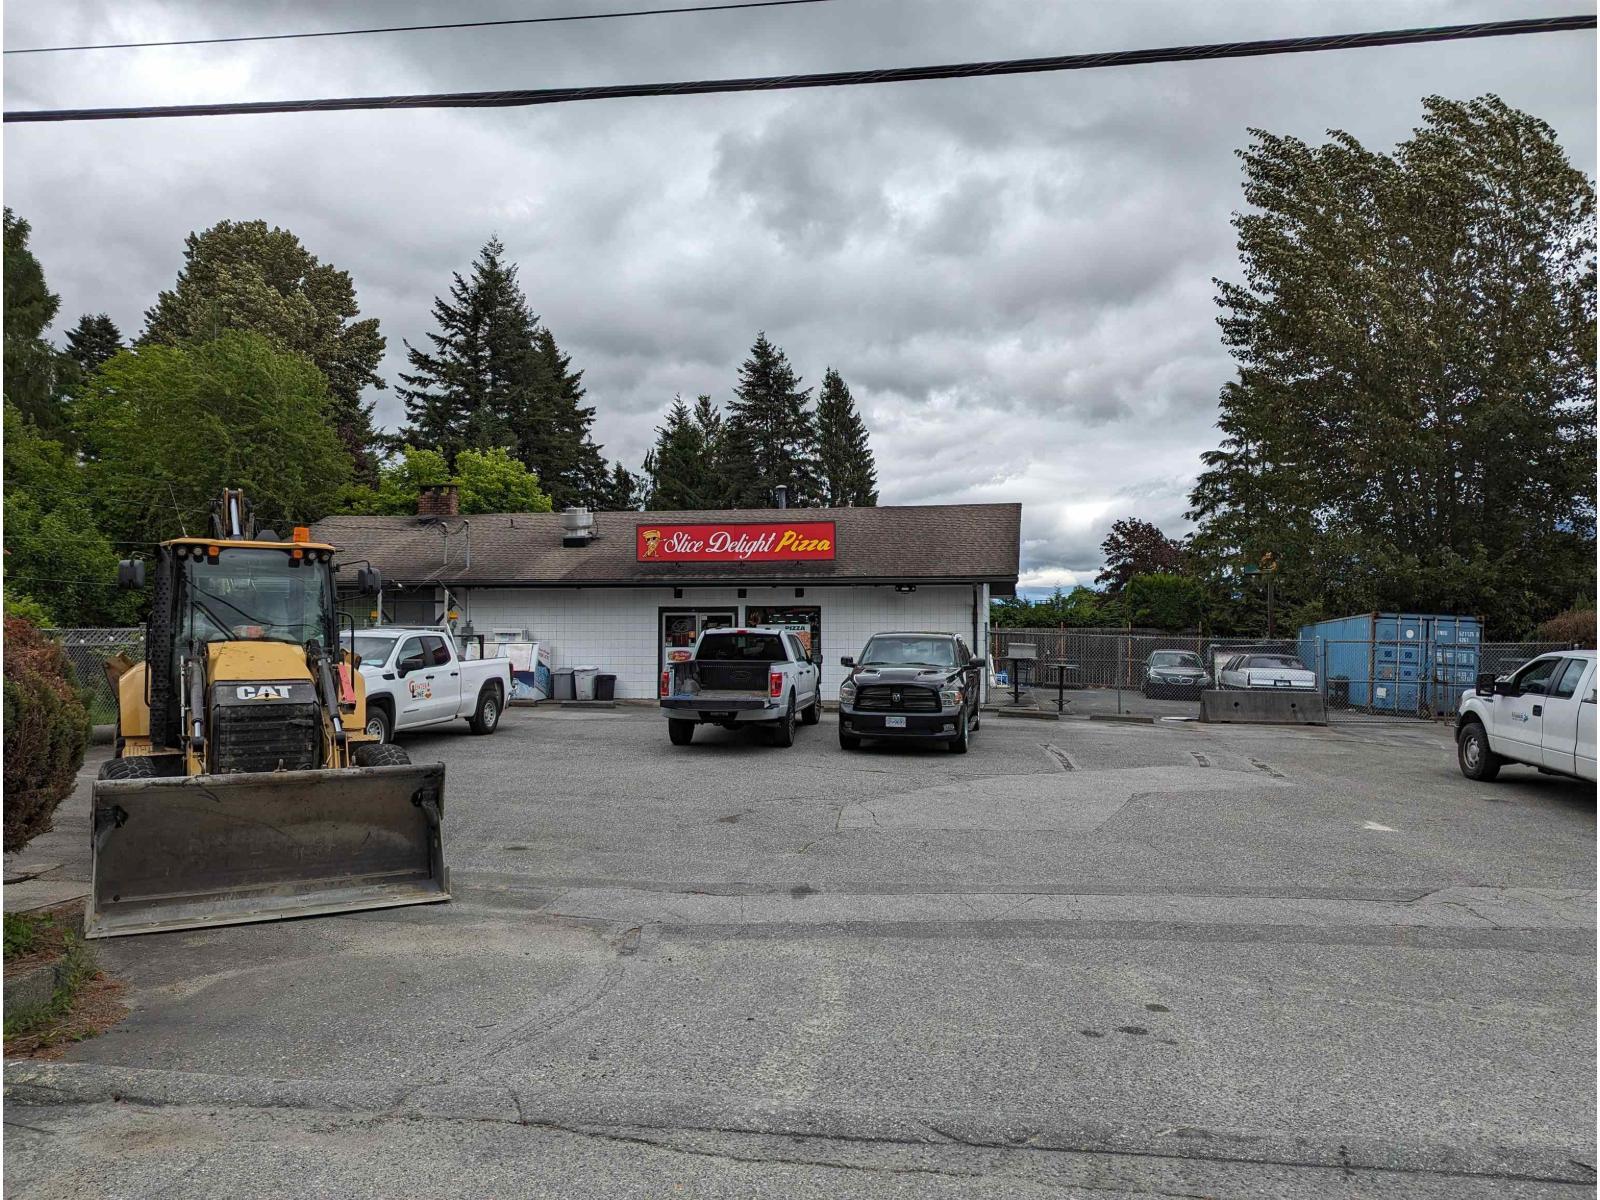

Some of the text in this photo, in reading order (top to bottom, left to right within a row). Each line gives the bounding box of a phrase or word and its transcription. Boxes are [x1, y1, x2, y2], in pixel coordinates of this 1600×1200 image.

[663, 529, 831, 559] Slice Delight Pizza
[236, 686, 293, 700] CAT
